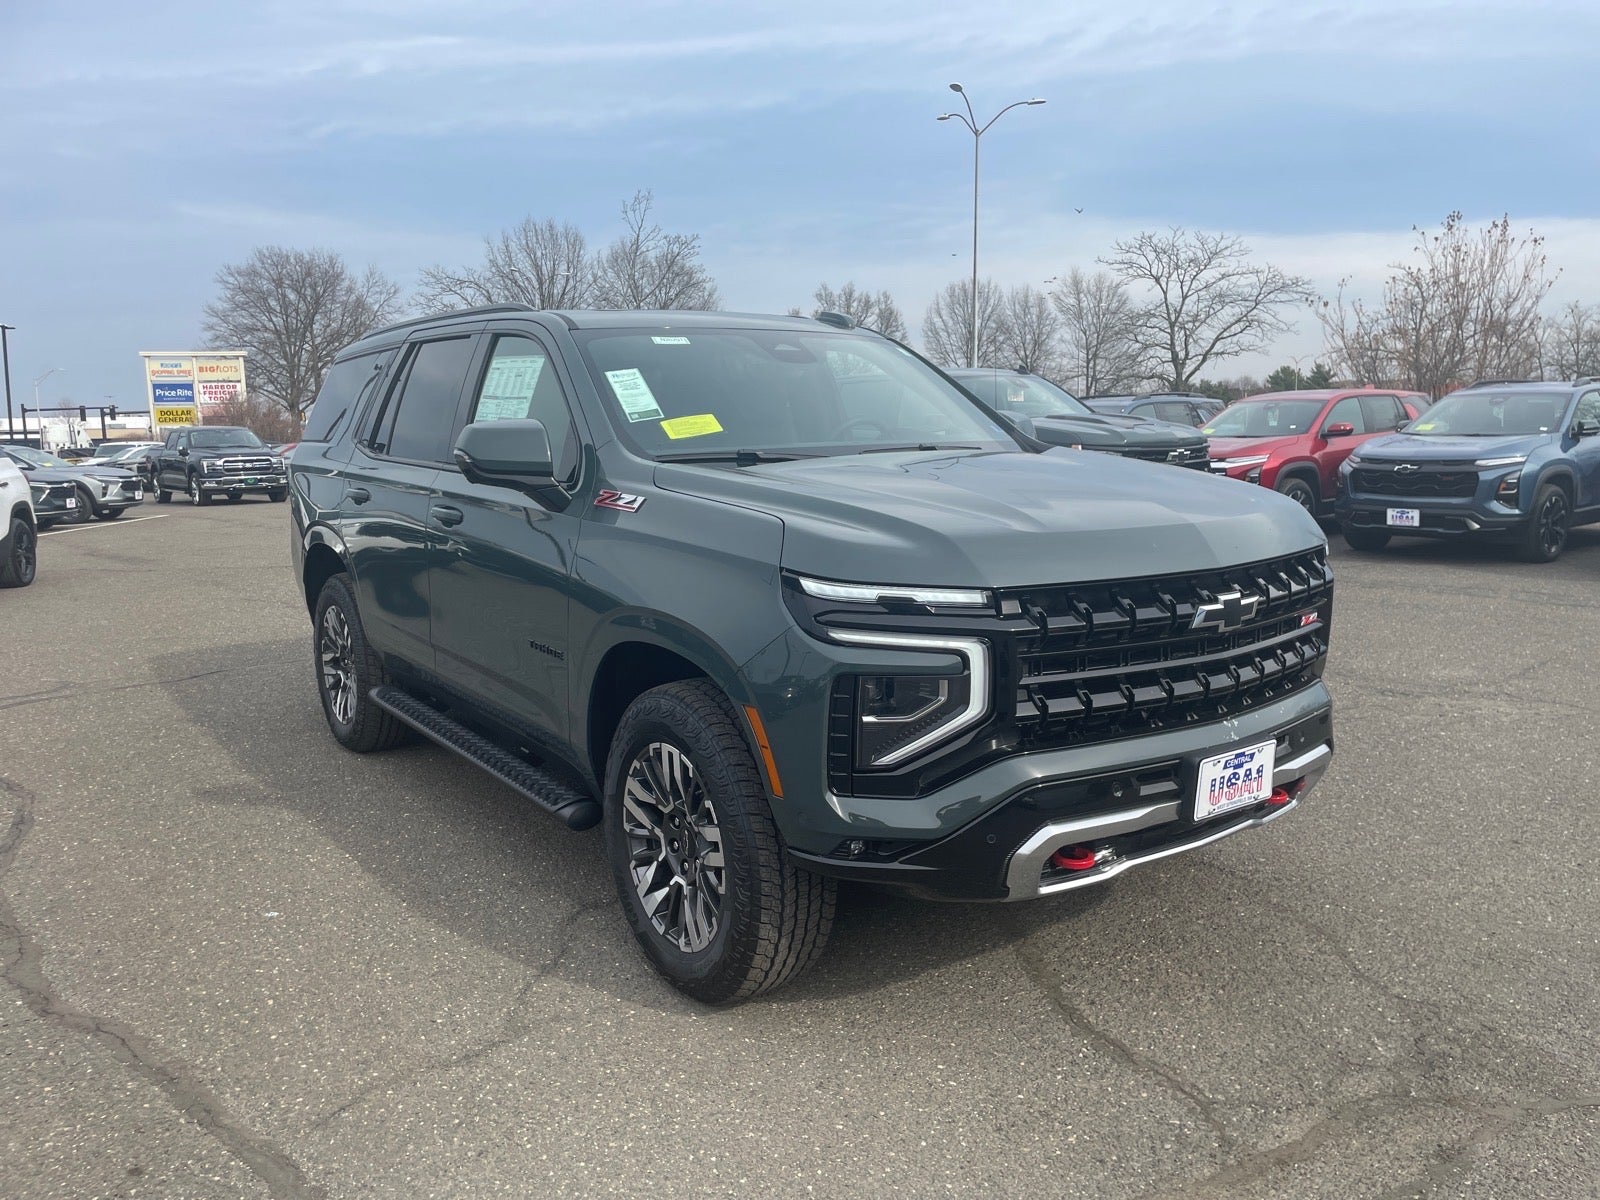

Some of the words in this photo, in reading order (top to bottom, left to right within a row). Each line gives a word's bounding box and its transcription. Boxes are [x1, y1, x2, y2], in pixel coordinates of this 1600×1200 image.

[155, 388, 176, 397] Price
[177, 388, 193, 397] Rite
[1226, 755, 1252, 767] CENTRAL
